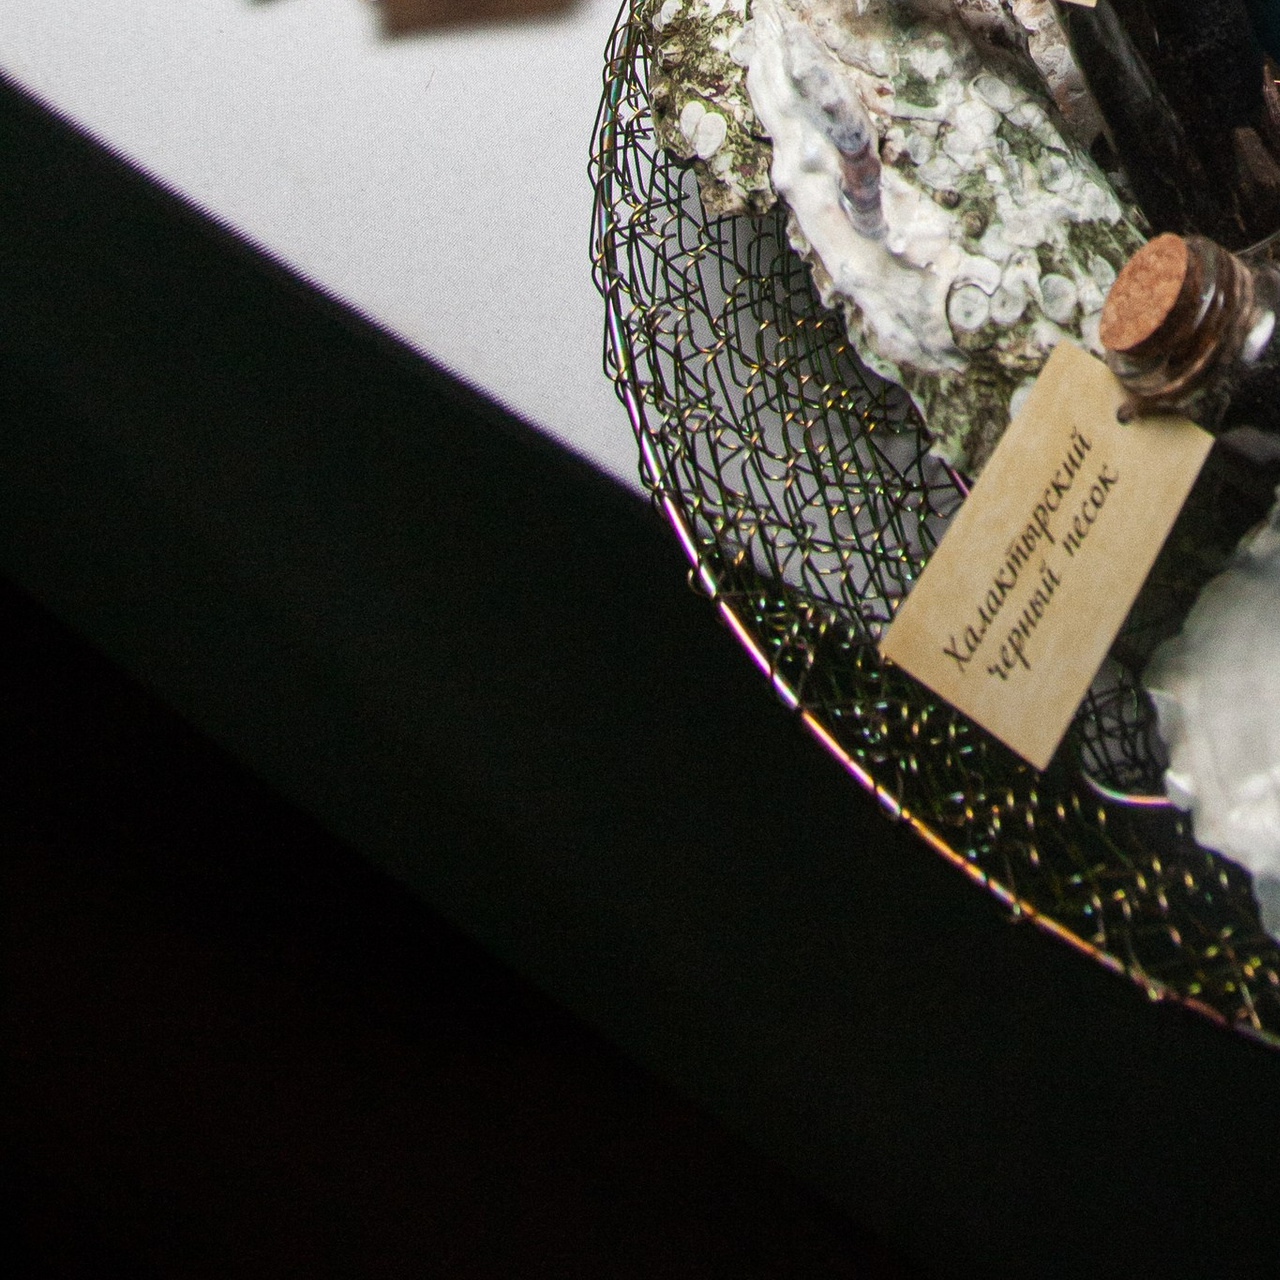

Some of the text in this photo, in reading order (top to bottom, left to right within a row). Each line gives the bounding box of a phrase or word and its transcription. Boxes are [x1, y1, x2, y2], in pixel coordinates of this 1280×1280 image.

[943, 425, 1094, 674] Халактырский
[986, 464, 1120, 681] черный песок
